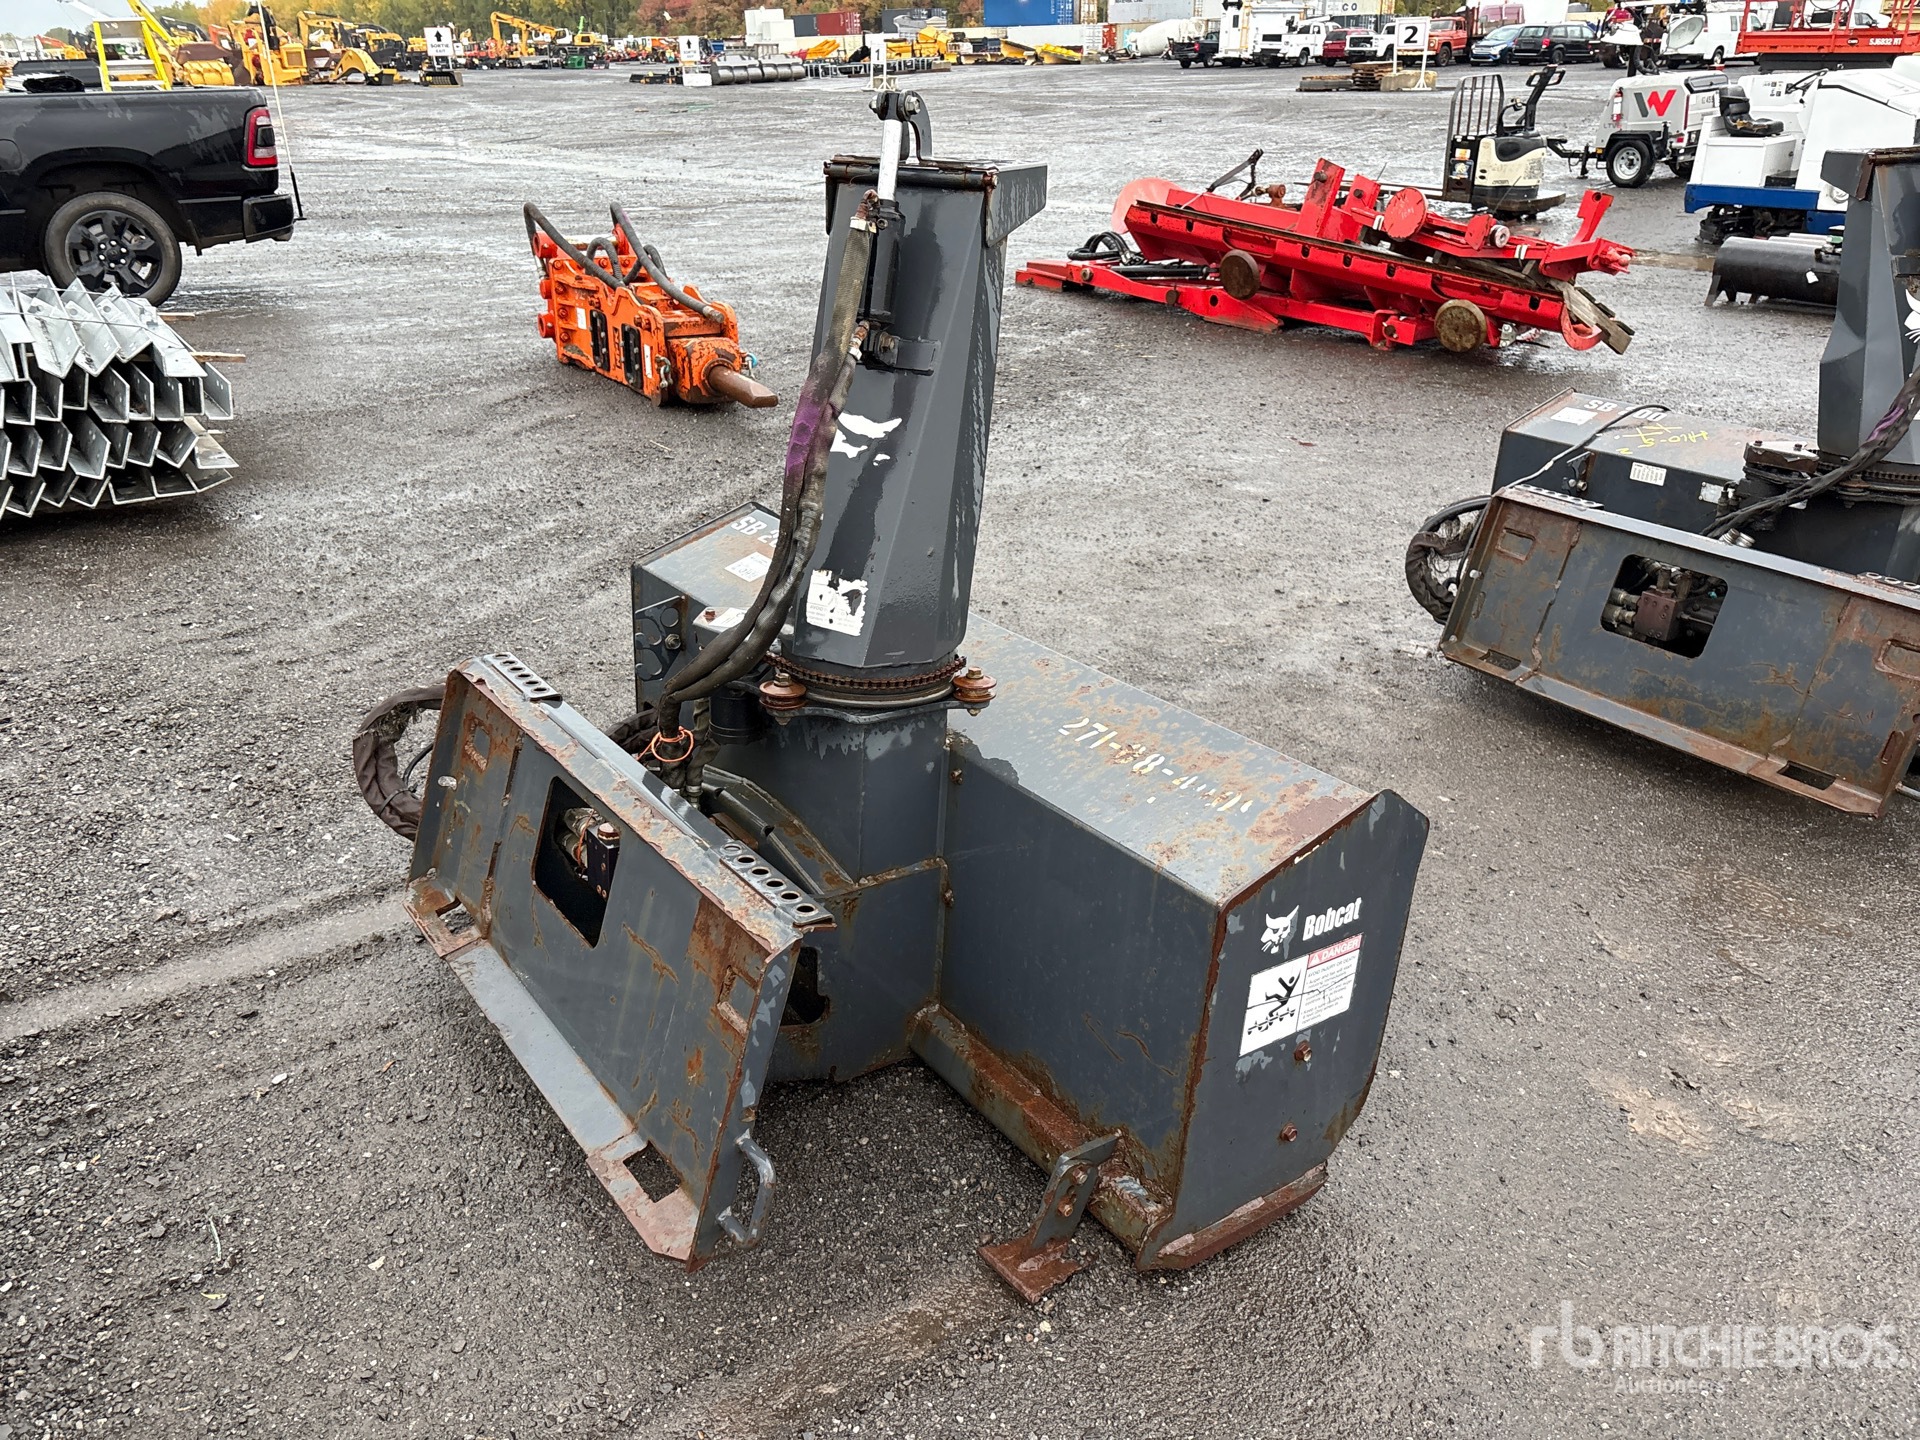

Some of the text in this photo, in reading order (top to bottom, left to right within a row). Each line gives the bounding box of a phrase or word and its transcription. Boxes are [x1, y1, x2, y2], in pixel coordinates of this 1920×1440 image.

[1404, 26, 1418, 44] 2
[1869, 38, 1903, 46] SJ6832 RT
[875, 48, 880, 60] 1
[1584, 399, 1618, 412] SB
[730, 516, 768, 535] SB
[1302, 896, 1362, 941] Bobcat
[1321, 938, 1360, 959] DANGER
